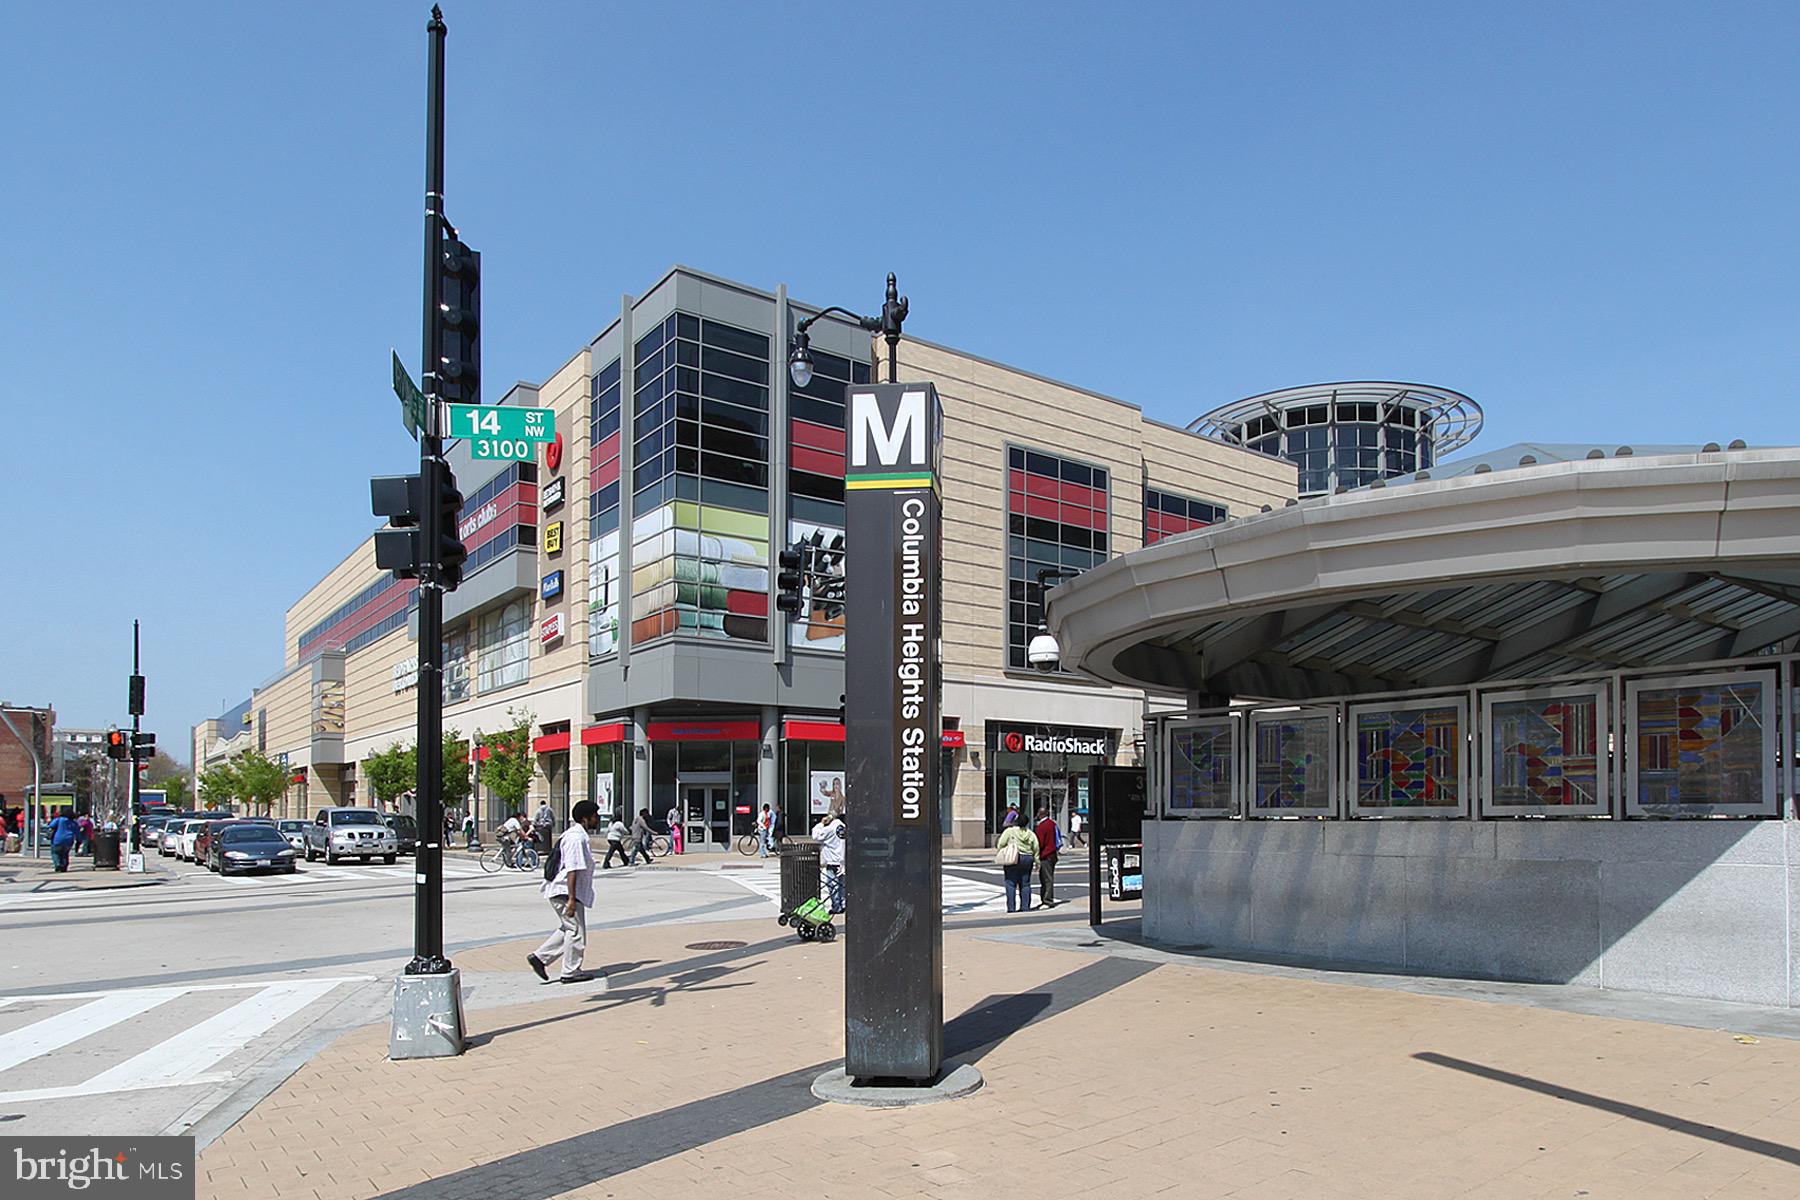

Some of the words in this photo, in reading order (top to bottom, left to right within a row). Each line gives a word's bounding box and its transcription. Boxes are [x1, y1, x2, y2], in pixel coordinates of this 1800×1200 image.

[466, 409, 501, 436] 14
[525, 411, 544, 424] ST
[524, 425, 545, 437] NW
[852, 392, 925, 466] M
[477, 440, 528, 458] 3100
[546, 527, 560, 540] BEST
[546, 538, 558, 549] BUY
[902, 499, 925, 615] Columbia
[898, 623, 924, 719] Heights
[1024, 734, 1105, 755] RadioShack
[902, 727, 925, 819] Station
